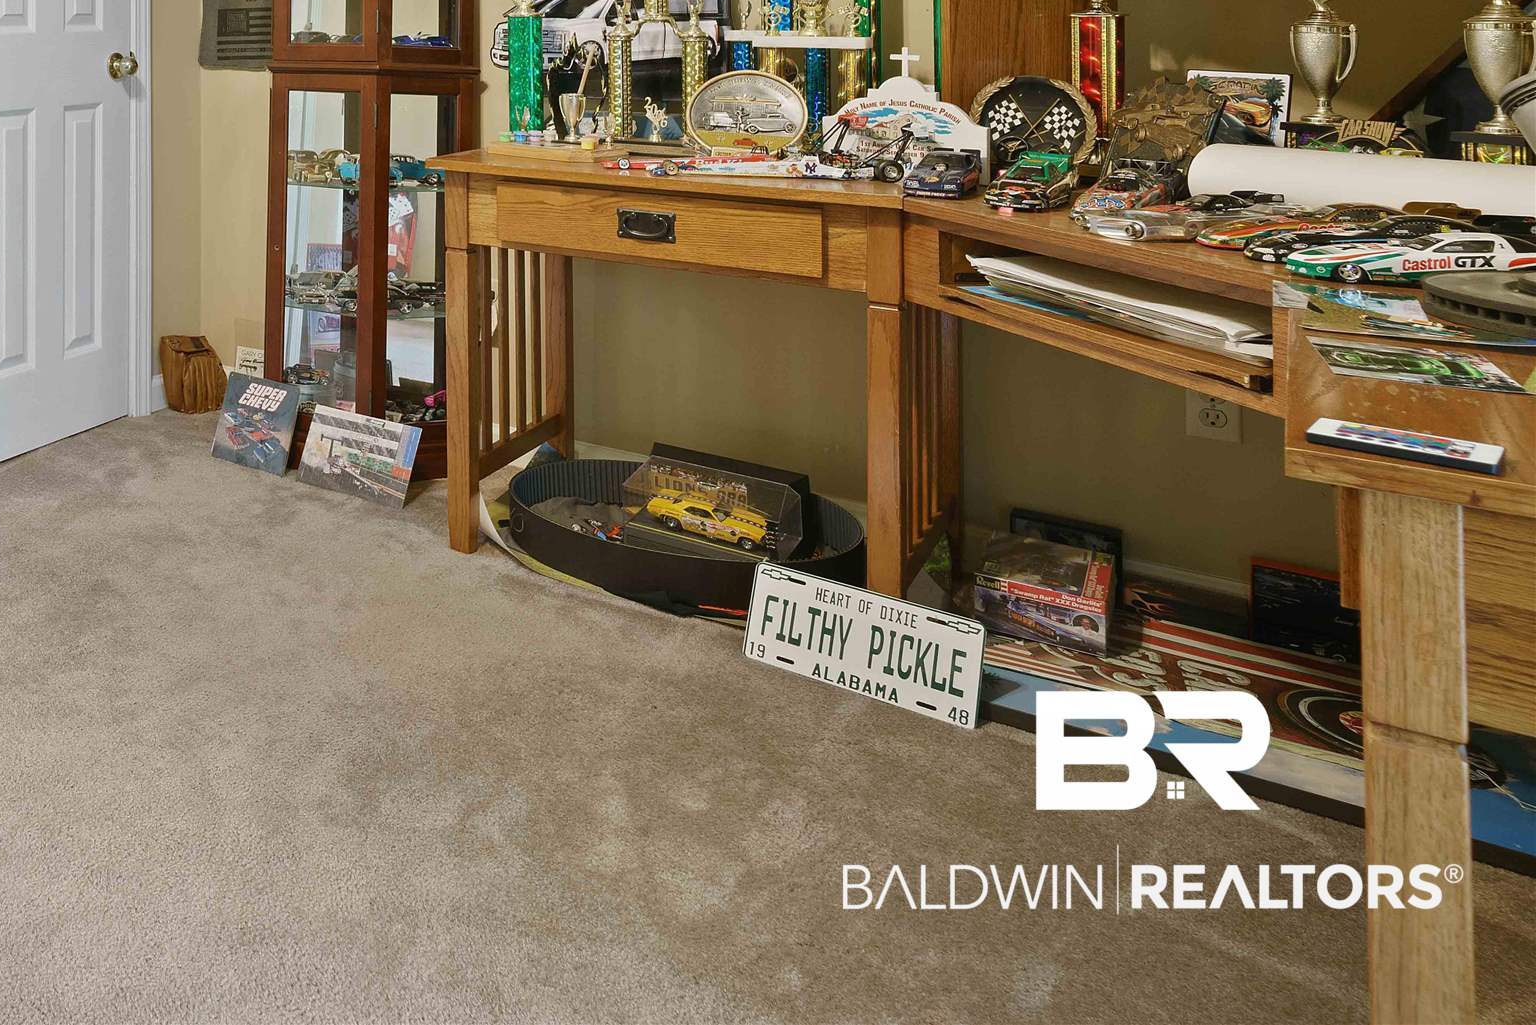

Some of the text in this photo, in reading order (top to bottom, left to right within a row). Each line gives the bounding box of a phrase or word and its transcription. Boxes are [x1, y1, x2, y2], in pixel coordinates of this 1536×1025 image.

[860, 101, 878, 111] NAME
[888, 98, 908, 107] JESUS
[909, 100, 938, 114] CATHOLIC
[938, 107, 961, 125] PARISH
[1339, 119, 1396, 145] CAR SHOW
[1402, 255, 1496, 272] Castrol GTX
[246, 382, 288, 401] SUPER
[238, 393, 281, 412] CHEVY
[976, 576, 1001, 591] Revell
[815, 586, 919, 629] HEART OF DIXIE
[1055, 597, 1071, 606] XXX
[1071, 600, 1102, 613] Dragster
[1061, 594, 1076, 602] Don
[760, 594, 967, 699] FILTHY PICKLE
[748, 640, 970, 726] 19 ALABAMA 48
